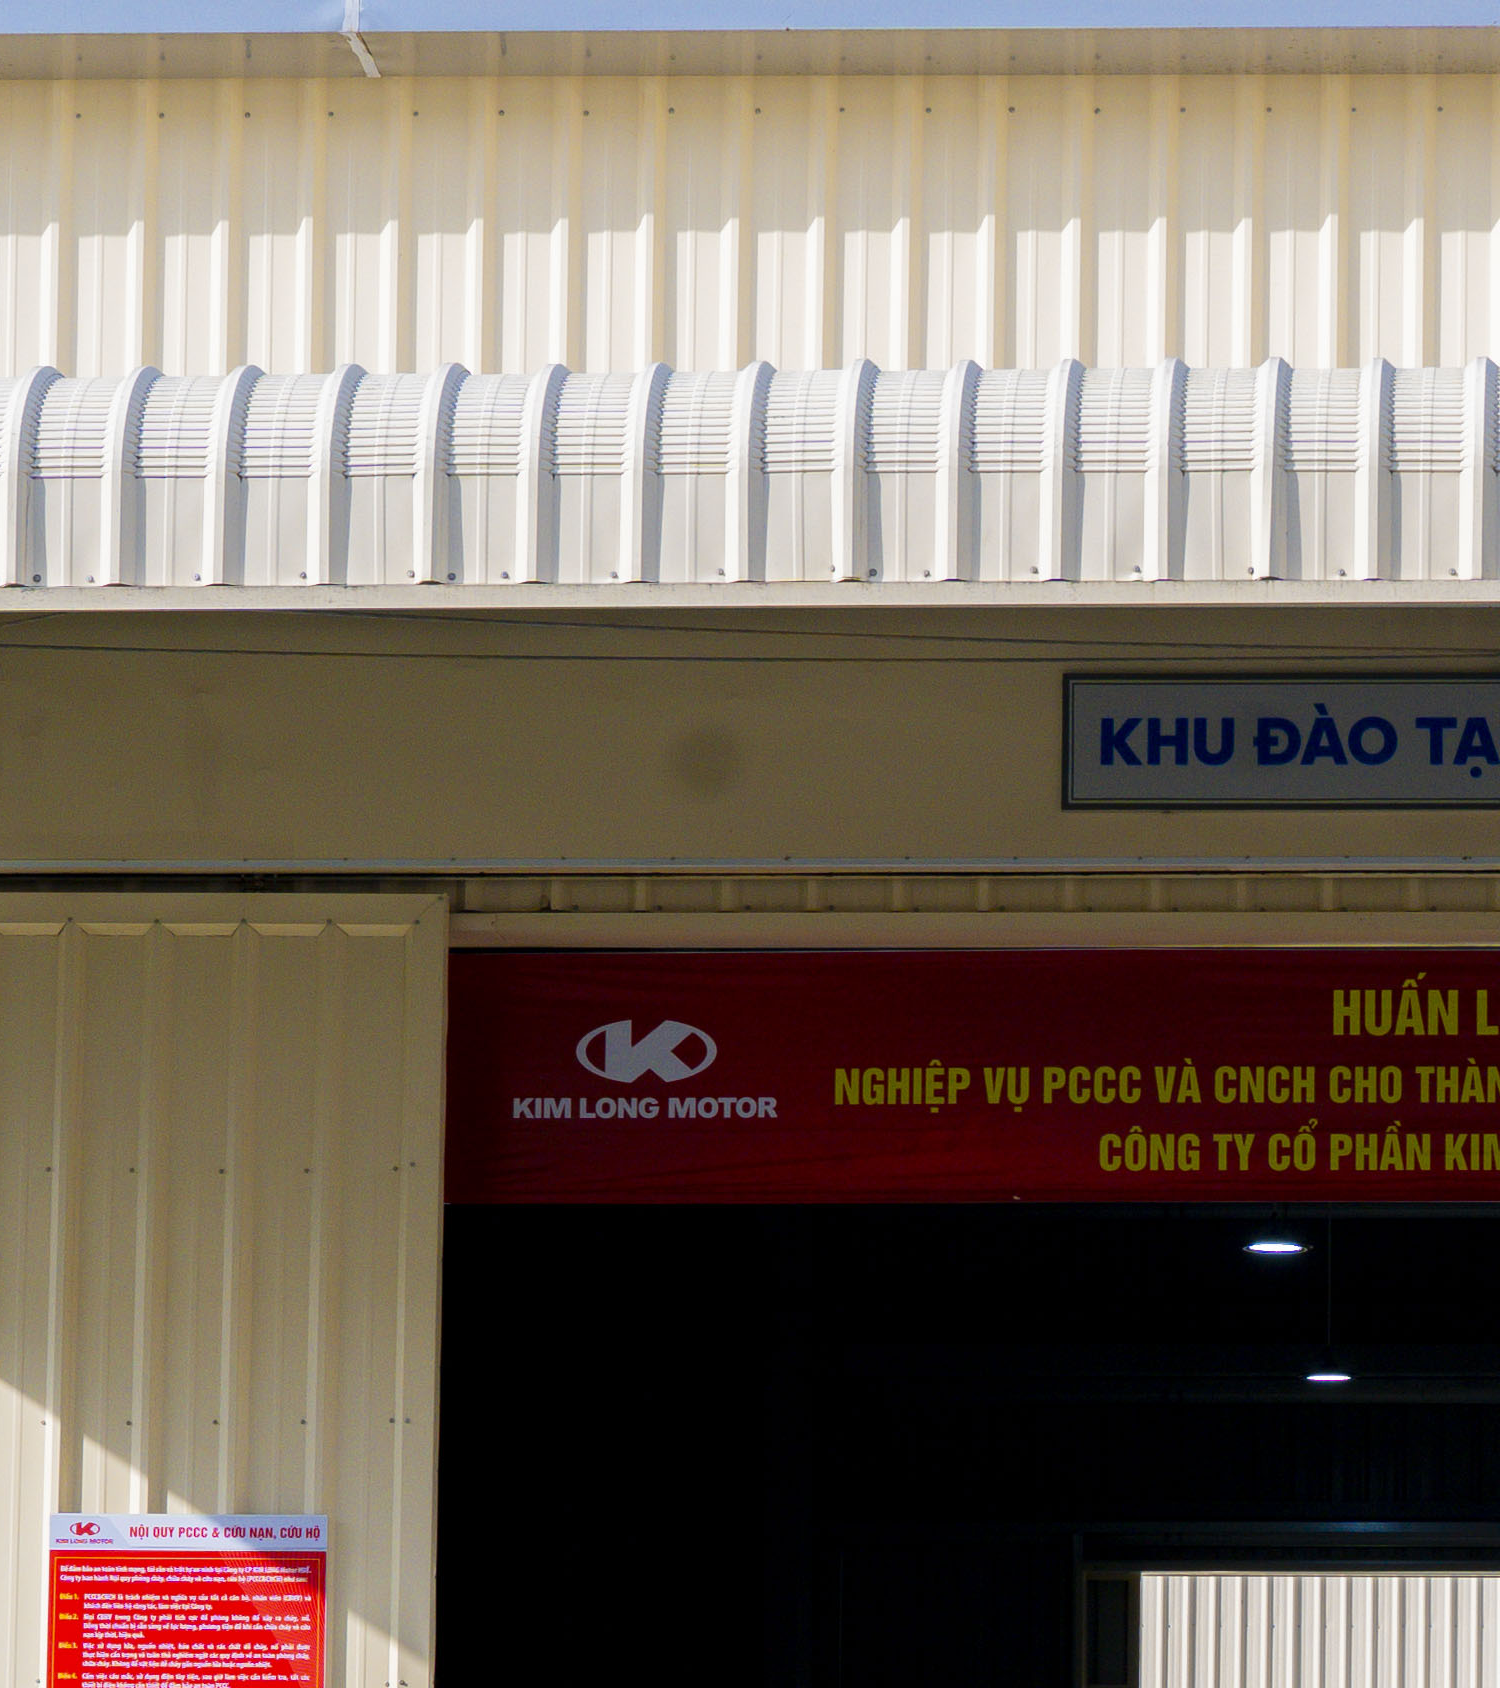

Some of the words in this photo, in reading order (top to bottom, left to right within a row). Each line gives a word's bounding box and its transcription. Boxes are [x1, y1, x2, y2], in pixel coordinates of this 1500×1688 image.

[1100, 717, 1235, 766] KHU
[1252, 703, 1398, 767] ĐÀO
[1333, 972, 1459, 1036] HUẤN
[513, 1097, 572, 1119] KIM
[579, 1097, 660, 1119] LONG
[668, 1097, 778, 1118] MOTOR
[834, 1059, 971, 1113] NGHIỆP
[983, 1067, 1030, 1112] VỤ
[1043, 1066, 1141, 1104] PCCC
[1154, 1058, 1201, 1103] VÀ
[1214, 1066, 1315, 1104] CNCH
[1329, 1065, 1402, 1104] CHO
[1099, 1126, 1200, 1171] CÔNG
[1213, 1133, 1255, 1171] TY
[1268, 1118, 1318, 1171] CỔ
[1330, 1120, 1431, 1171] PHẦN
[130, 1524, 149, 1541] NỘI
[153, 1526, 174, 1539] QUY
[179, 1527, 207, 1538] PCCC
[212, 1527, 219, 1538] &
[224, 1525, 246, 1538] CỨU
[249, 1527, 277, 1541] NẠN,
[280, 1525, 302, 1539] CỨU
[305, 1525, 320, 1542] HỘ
